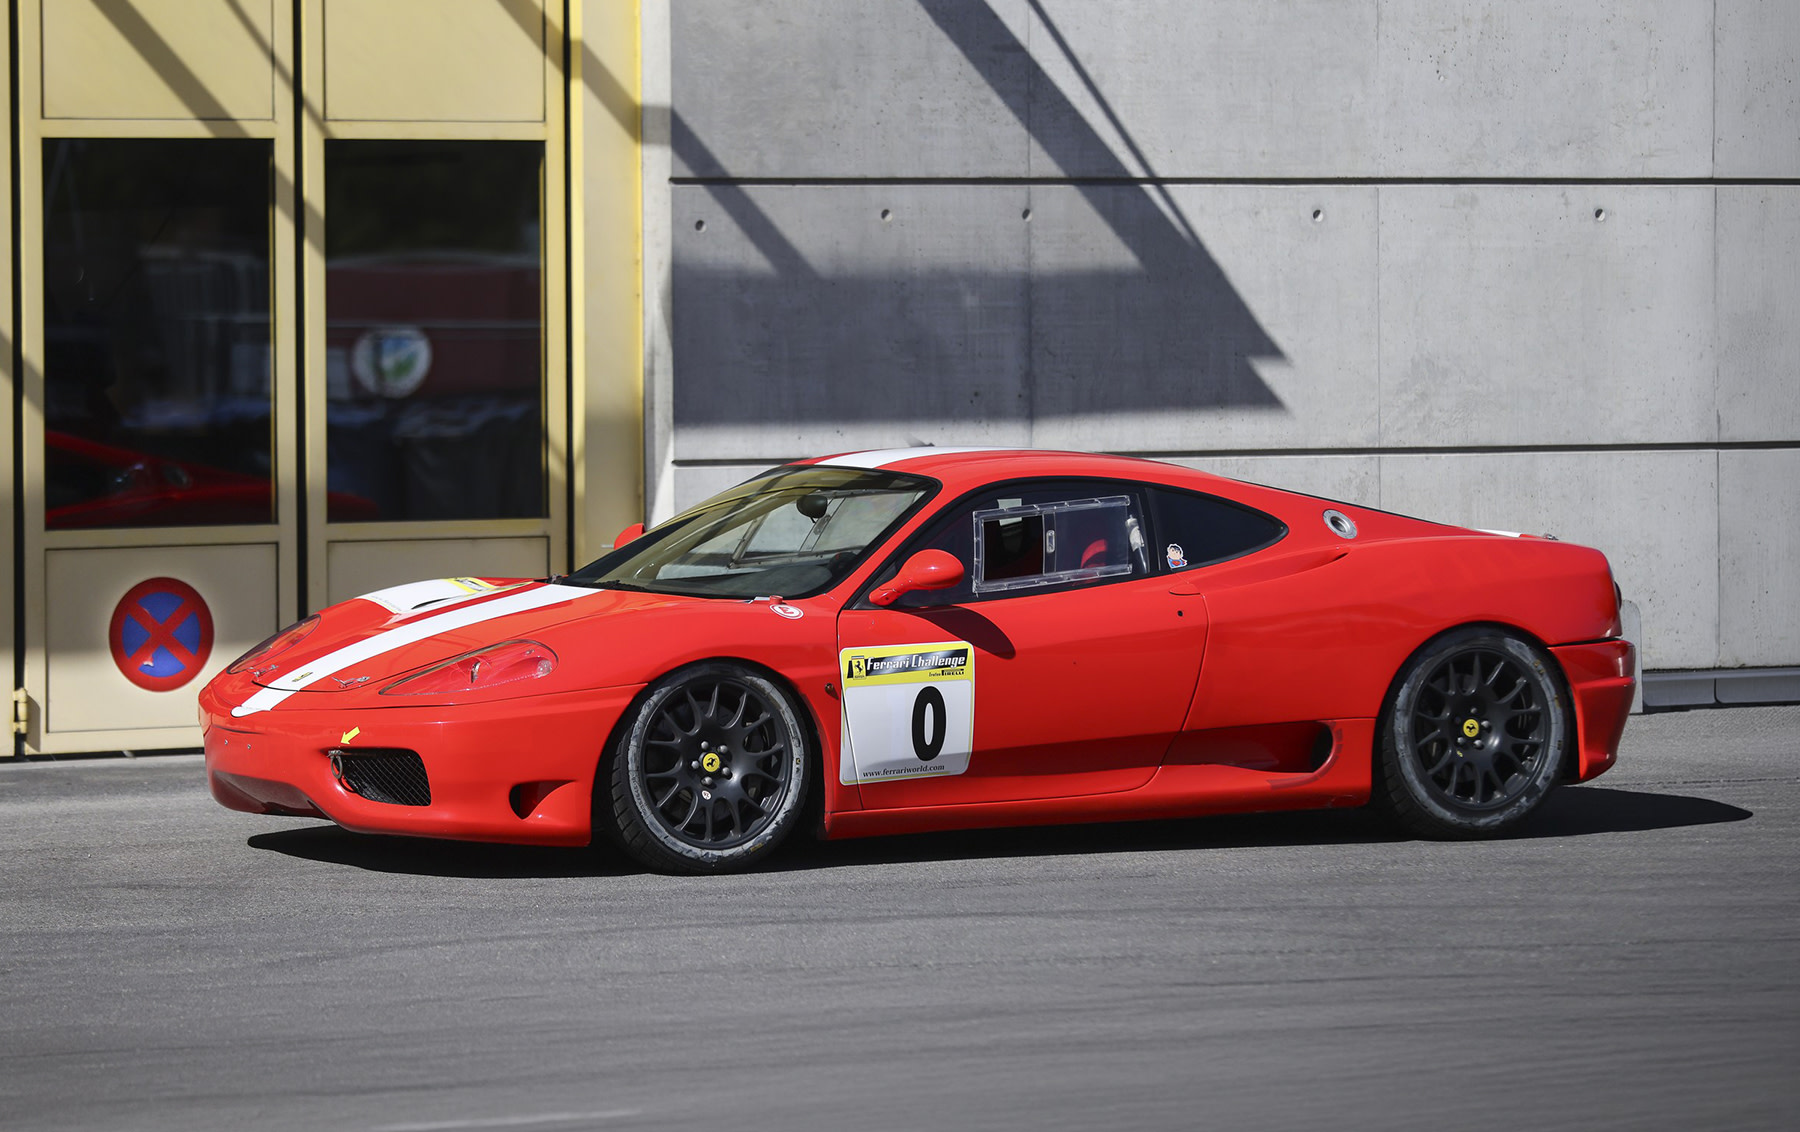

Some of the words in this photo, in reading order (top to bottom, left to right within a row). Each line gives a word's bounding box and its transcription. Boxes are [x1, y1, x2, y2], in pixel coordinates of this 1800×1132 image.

[867, 657, 910, 671] Ferrari
[911, 654, 966, 668] Challenge
[912, 686, 947, 762] 0
[863, 765, 945, 778] www.ferrariworld.com
